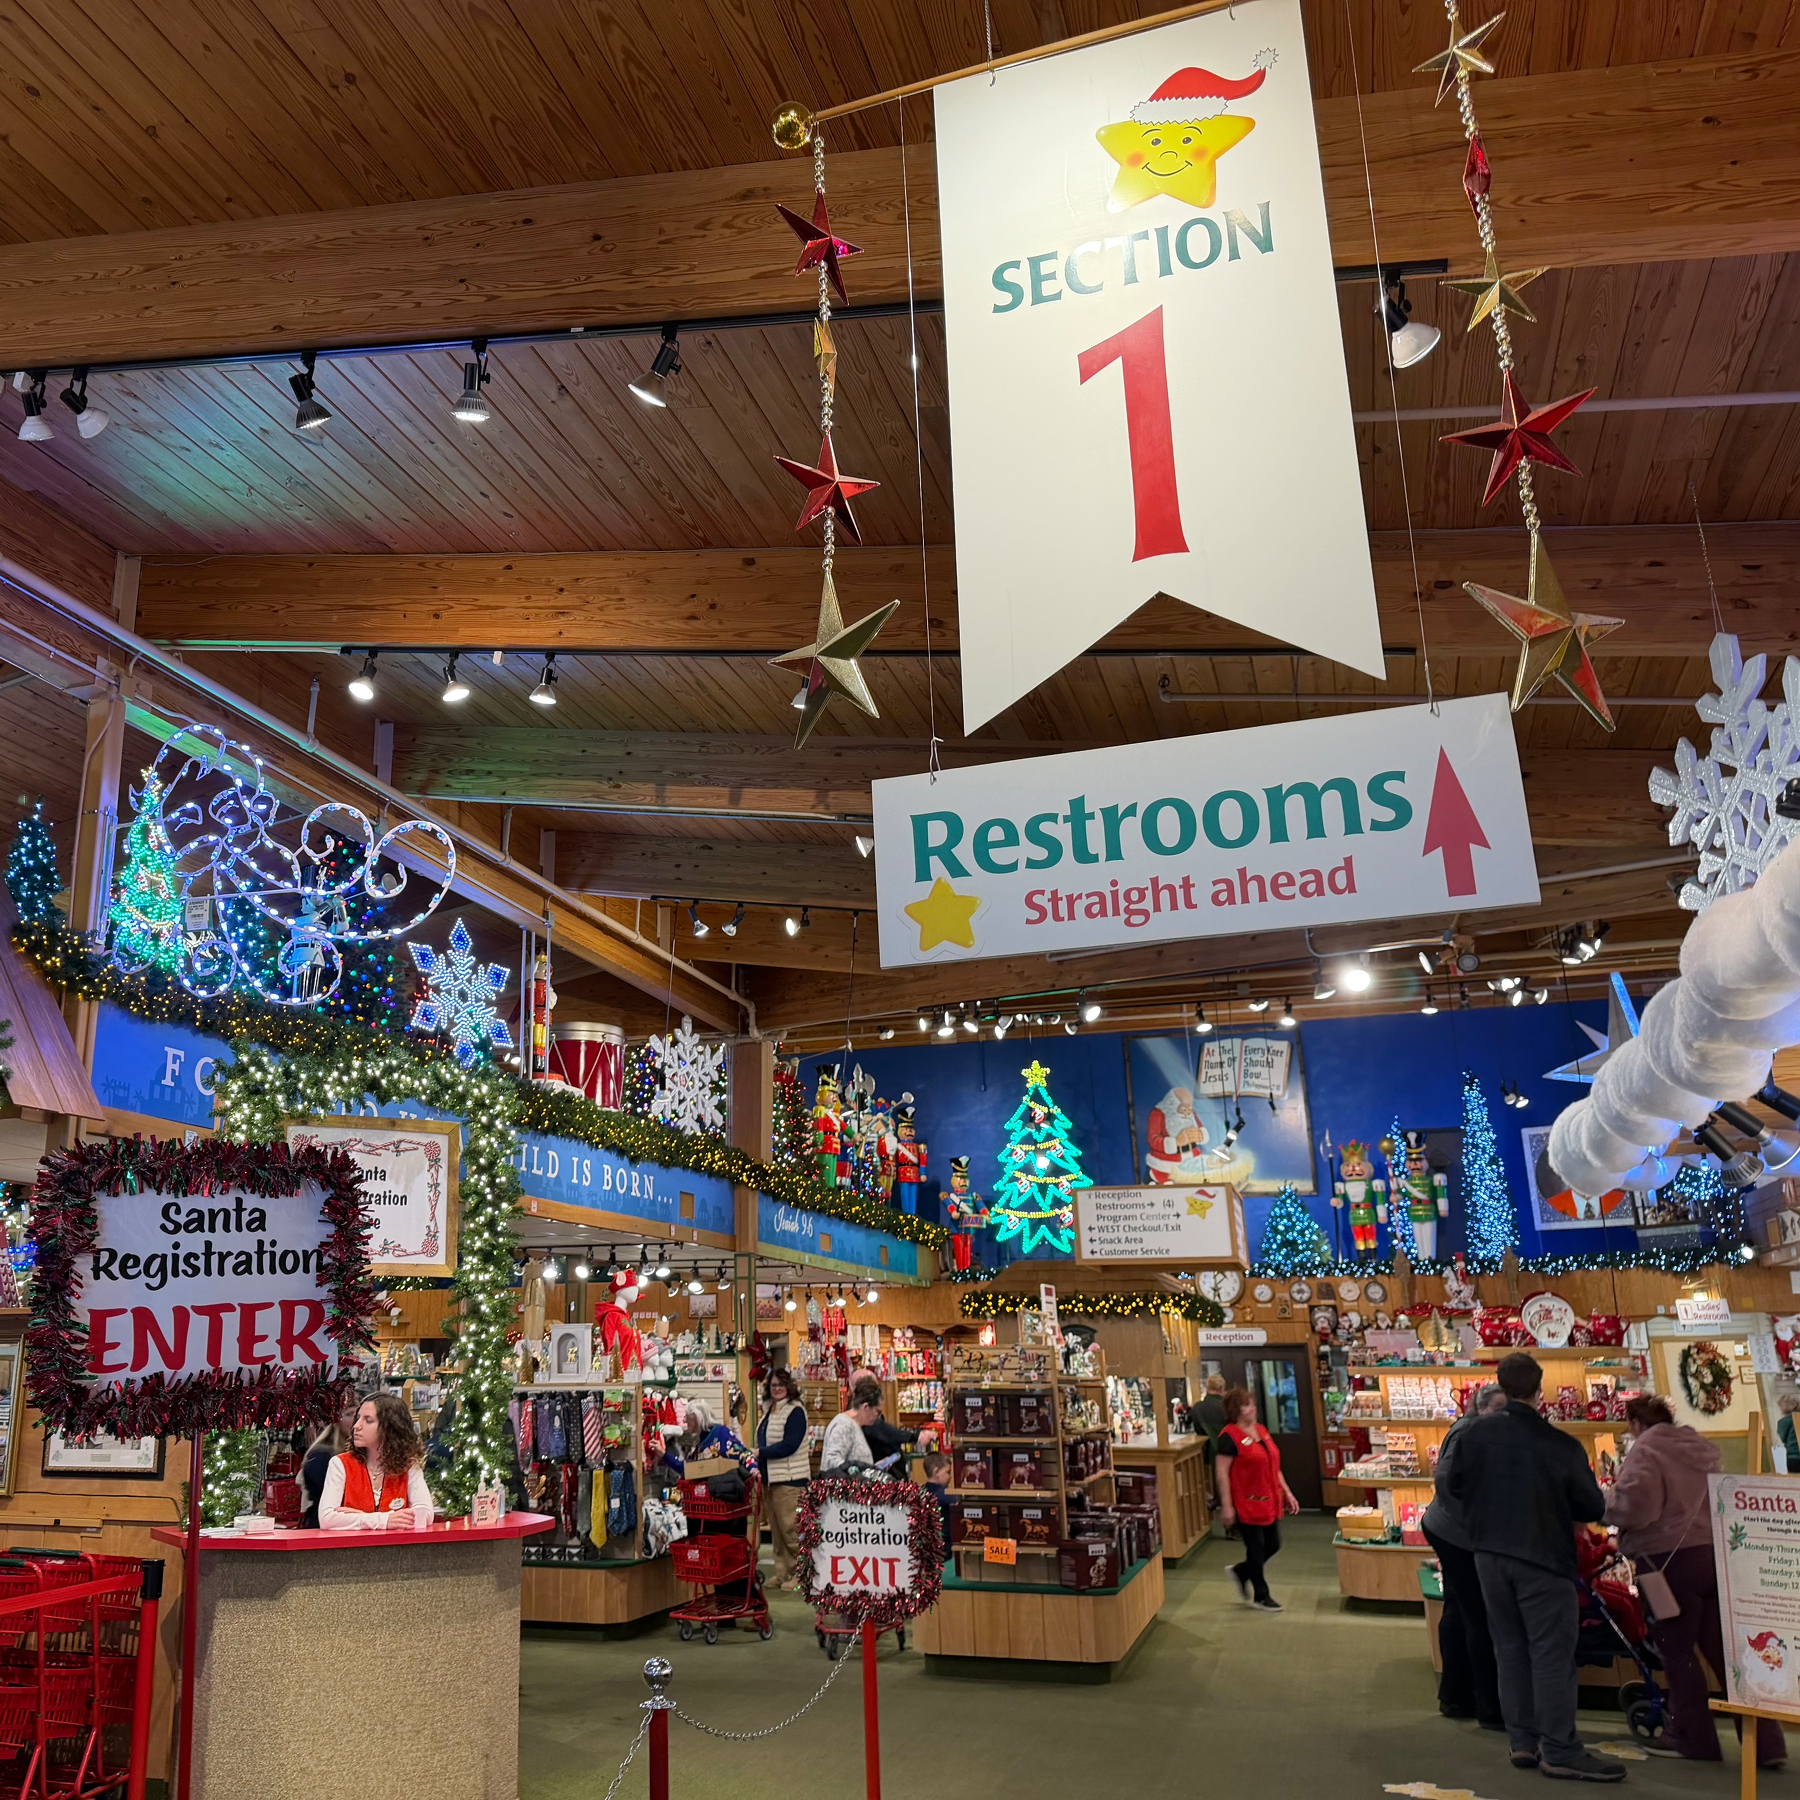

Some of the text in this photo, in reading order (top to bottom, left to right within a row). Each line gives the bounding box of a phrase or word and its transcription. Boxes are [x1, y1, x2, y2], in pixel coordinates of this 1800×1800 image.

[991, 200, 1274, 314] SECTION
[1077, 304, 1190, 563] 1
[908, 769, 1413, 883] Restrooms
[1024, 855, 1358, 928] Straight ahead
[1244, 1045, 1265, 1057] Every
[1243, 1057, 1274, 1069] Should
[1202, 1071, 1229, 1084] Jesus
[359, 1166, 387, 1182] anta
[571, 1157, 591, 1186] IS
[1094, 1190, 1142, 1201] Reception
[1095, 1199, 1174, 1210] Restrooms (4)
[159, 1196, 267, 1235] Santa
[1096, 1212, 1171, 1223] Program Center
[1097, 1223, 1181, 1234] WEST Checkout/Exit
[1098, 1235, 1143, 1245] Snack Area
[1099, 1246, 1170, 1256] Customer Service
[91, 1239, 323, 1291] Registration
[86, 1299, 329, 1374] ENTER
[1205, 1332, 1253, 1344] Reception
[1734, 1490, 1798, 1514] Santa
[839, 1508, 885, 1525] Santa
[989, 1546, 1010, 1556] SALE
[830, 1555, 901, 1588] EXIT
